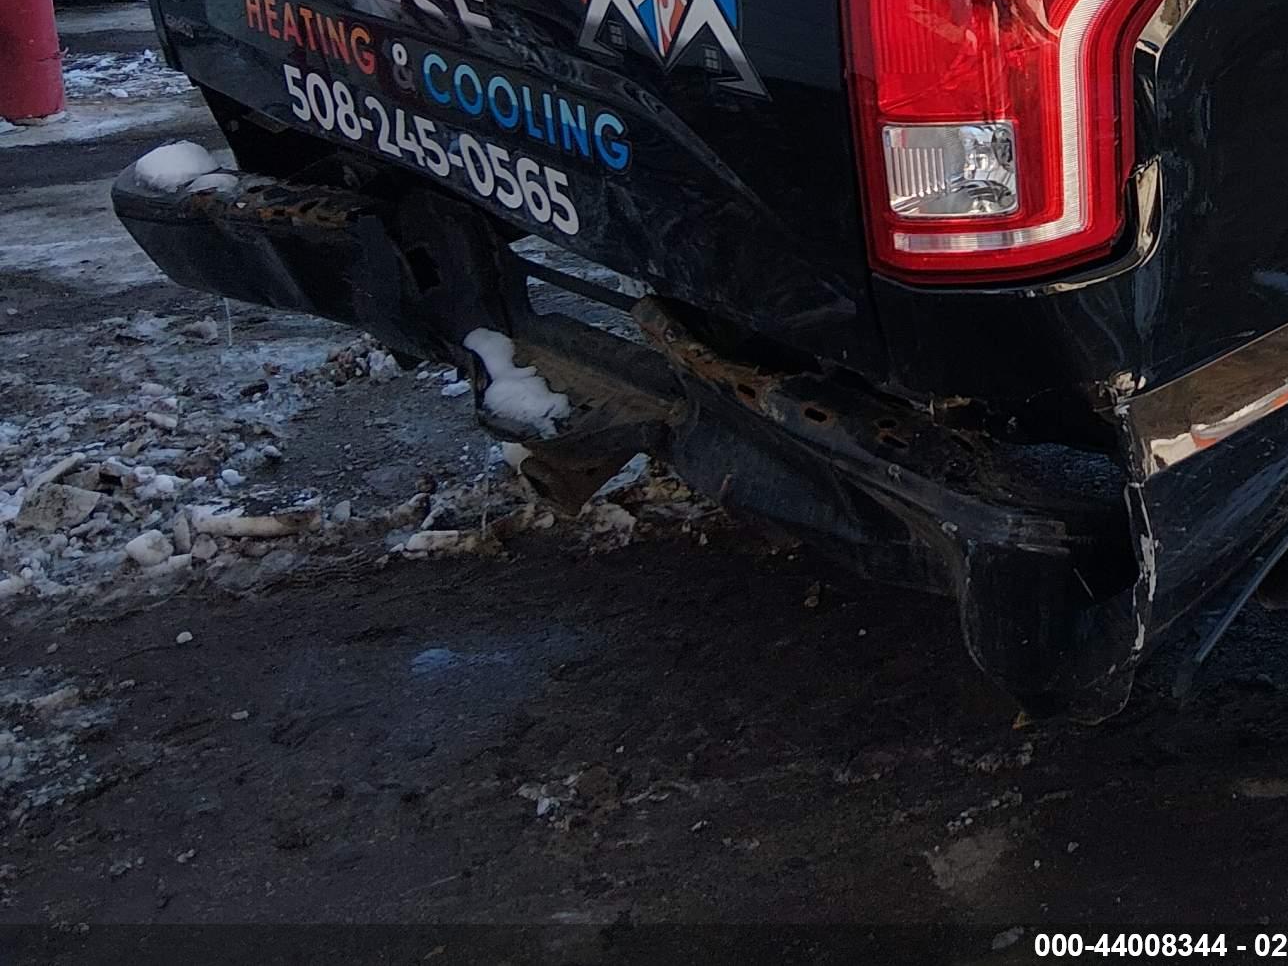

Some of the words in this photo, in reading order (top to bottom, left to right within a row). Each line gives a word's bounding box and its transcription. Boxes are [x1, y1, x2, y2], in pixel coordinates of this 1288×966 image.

[283, 64, 580, 235] 508-245-0565
[392, 42, 417, 93] &
[423, 52, 632, 171] COOLING
